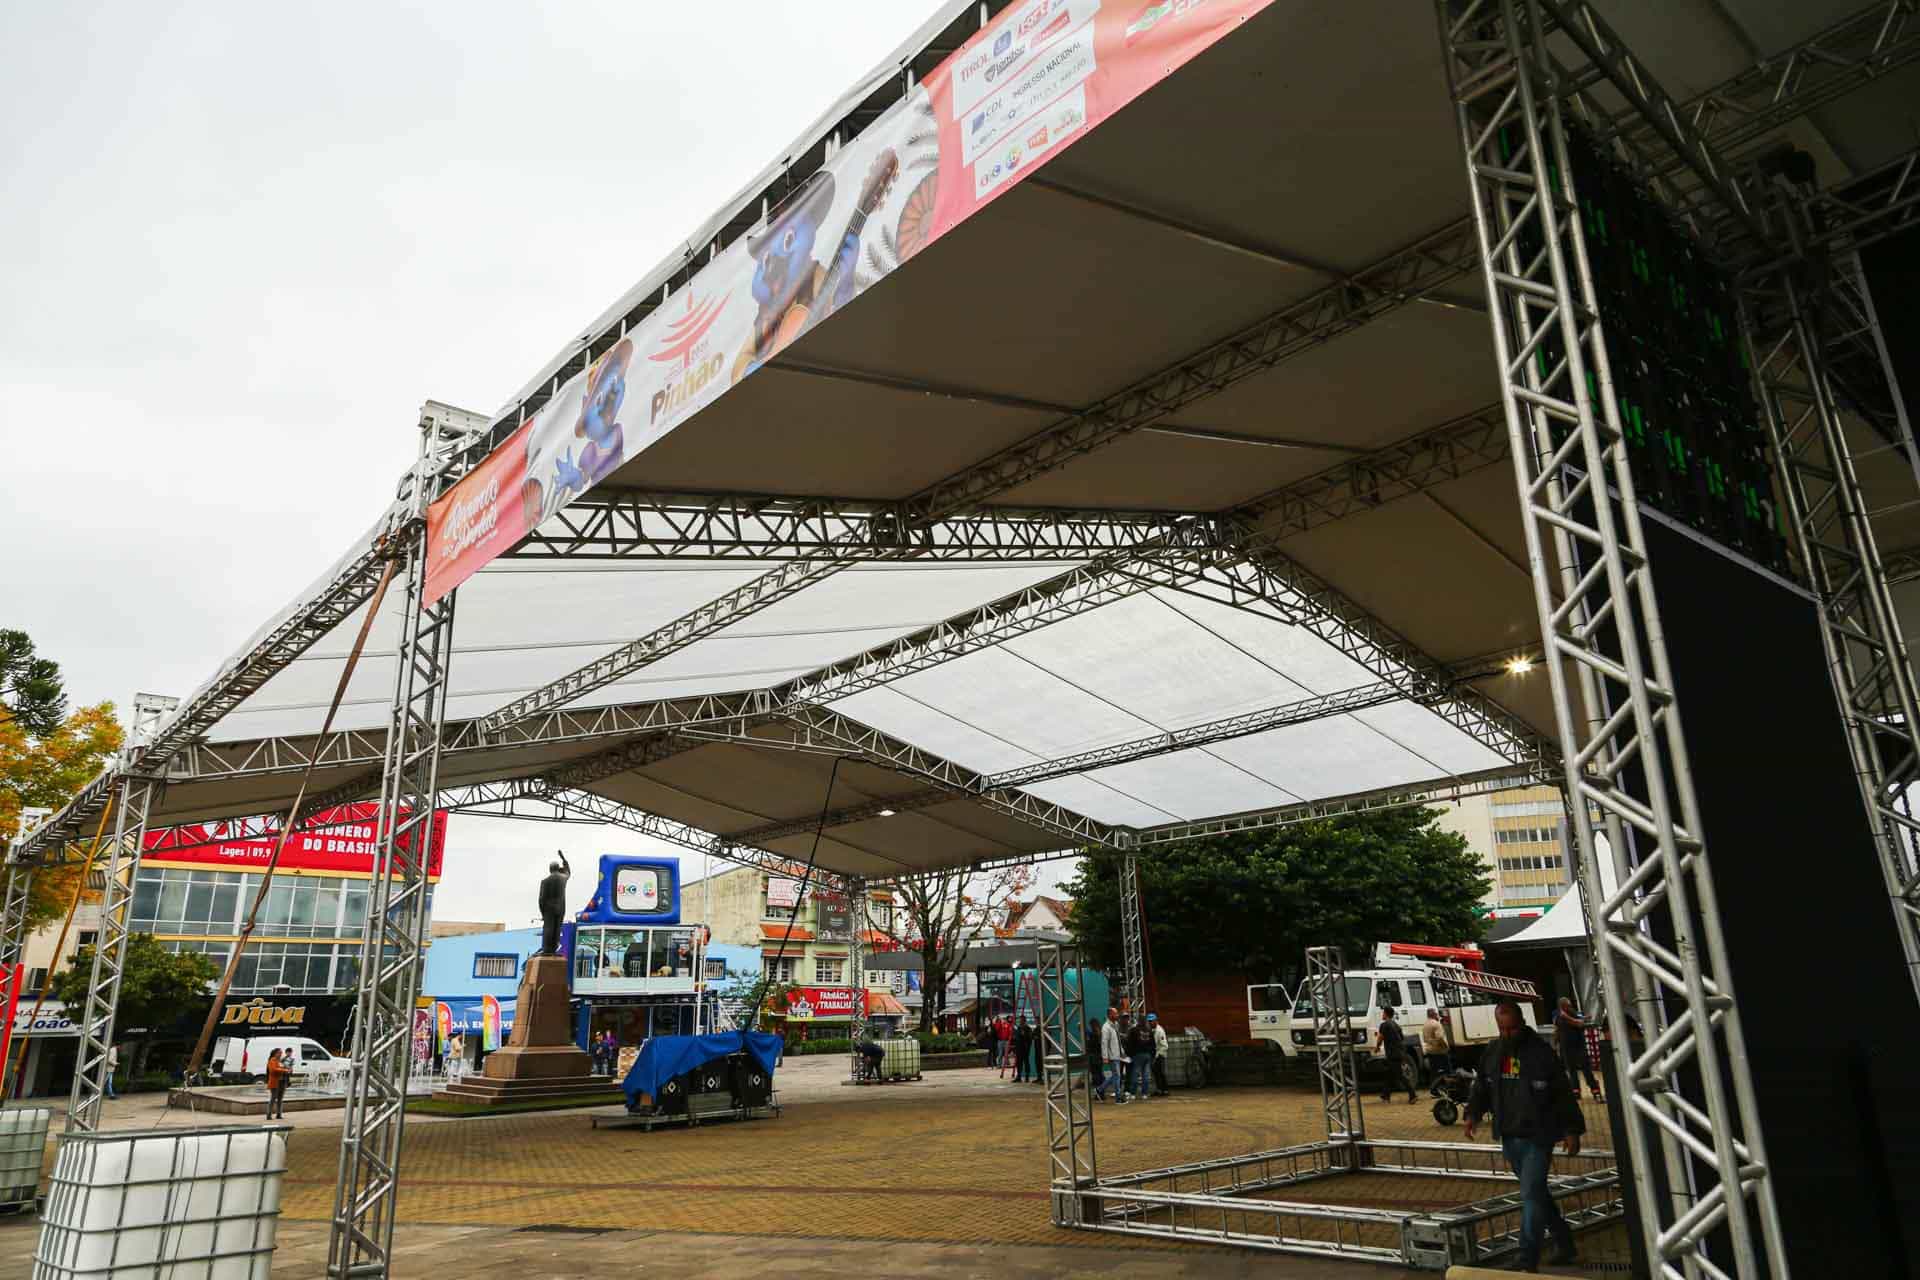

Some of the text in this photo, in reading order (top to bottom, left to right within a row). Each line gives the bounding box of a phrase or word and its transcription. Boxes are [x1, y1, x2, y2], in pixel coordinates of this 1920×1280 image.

[220, 845, 245, 857] Lages
[303, 838, 322, 851] DO
[327, 840, 376, 854] BRASIL
[220, 1003, 306, 1024] Diva
